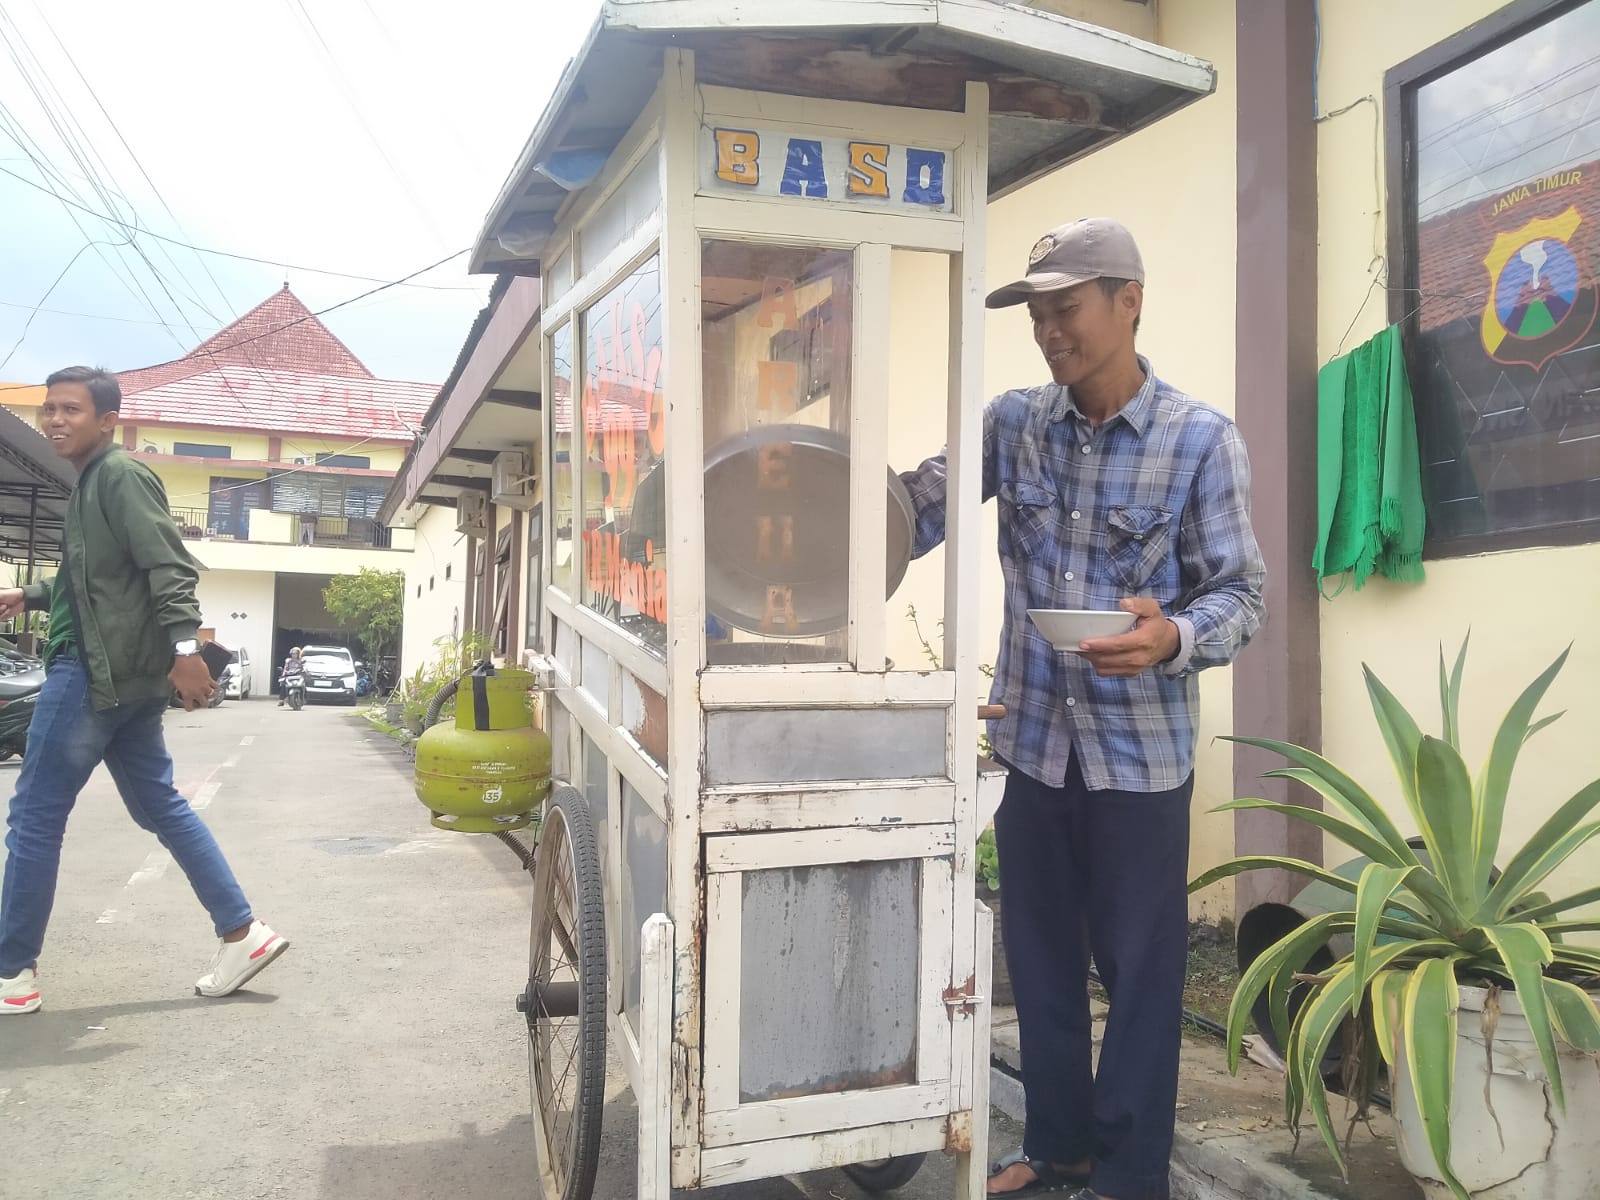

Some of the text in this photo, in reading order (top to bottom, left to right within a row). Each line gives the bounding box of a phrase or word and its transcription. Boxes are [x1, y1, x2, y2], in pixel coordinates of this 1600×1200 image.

[714, 127, 946, 204] BASO
[1492, 171, 1582, 216] JAWA TIMUR
